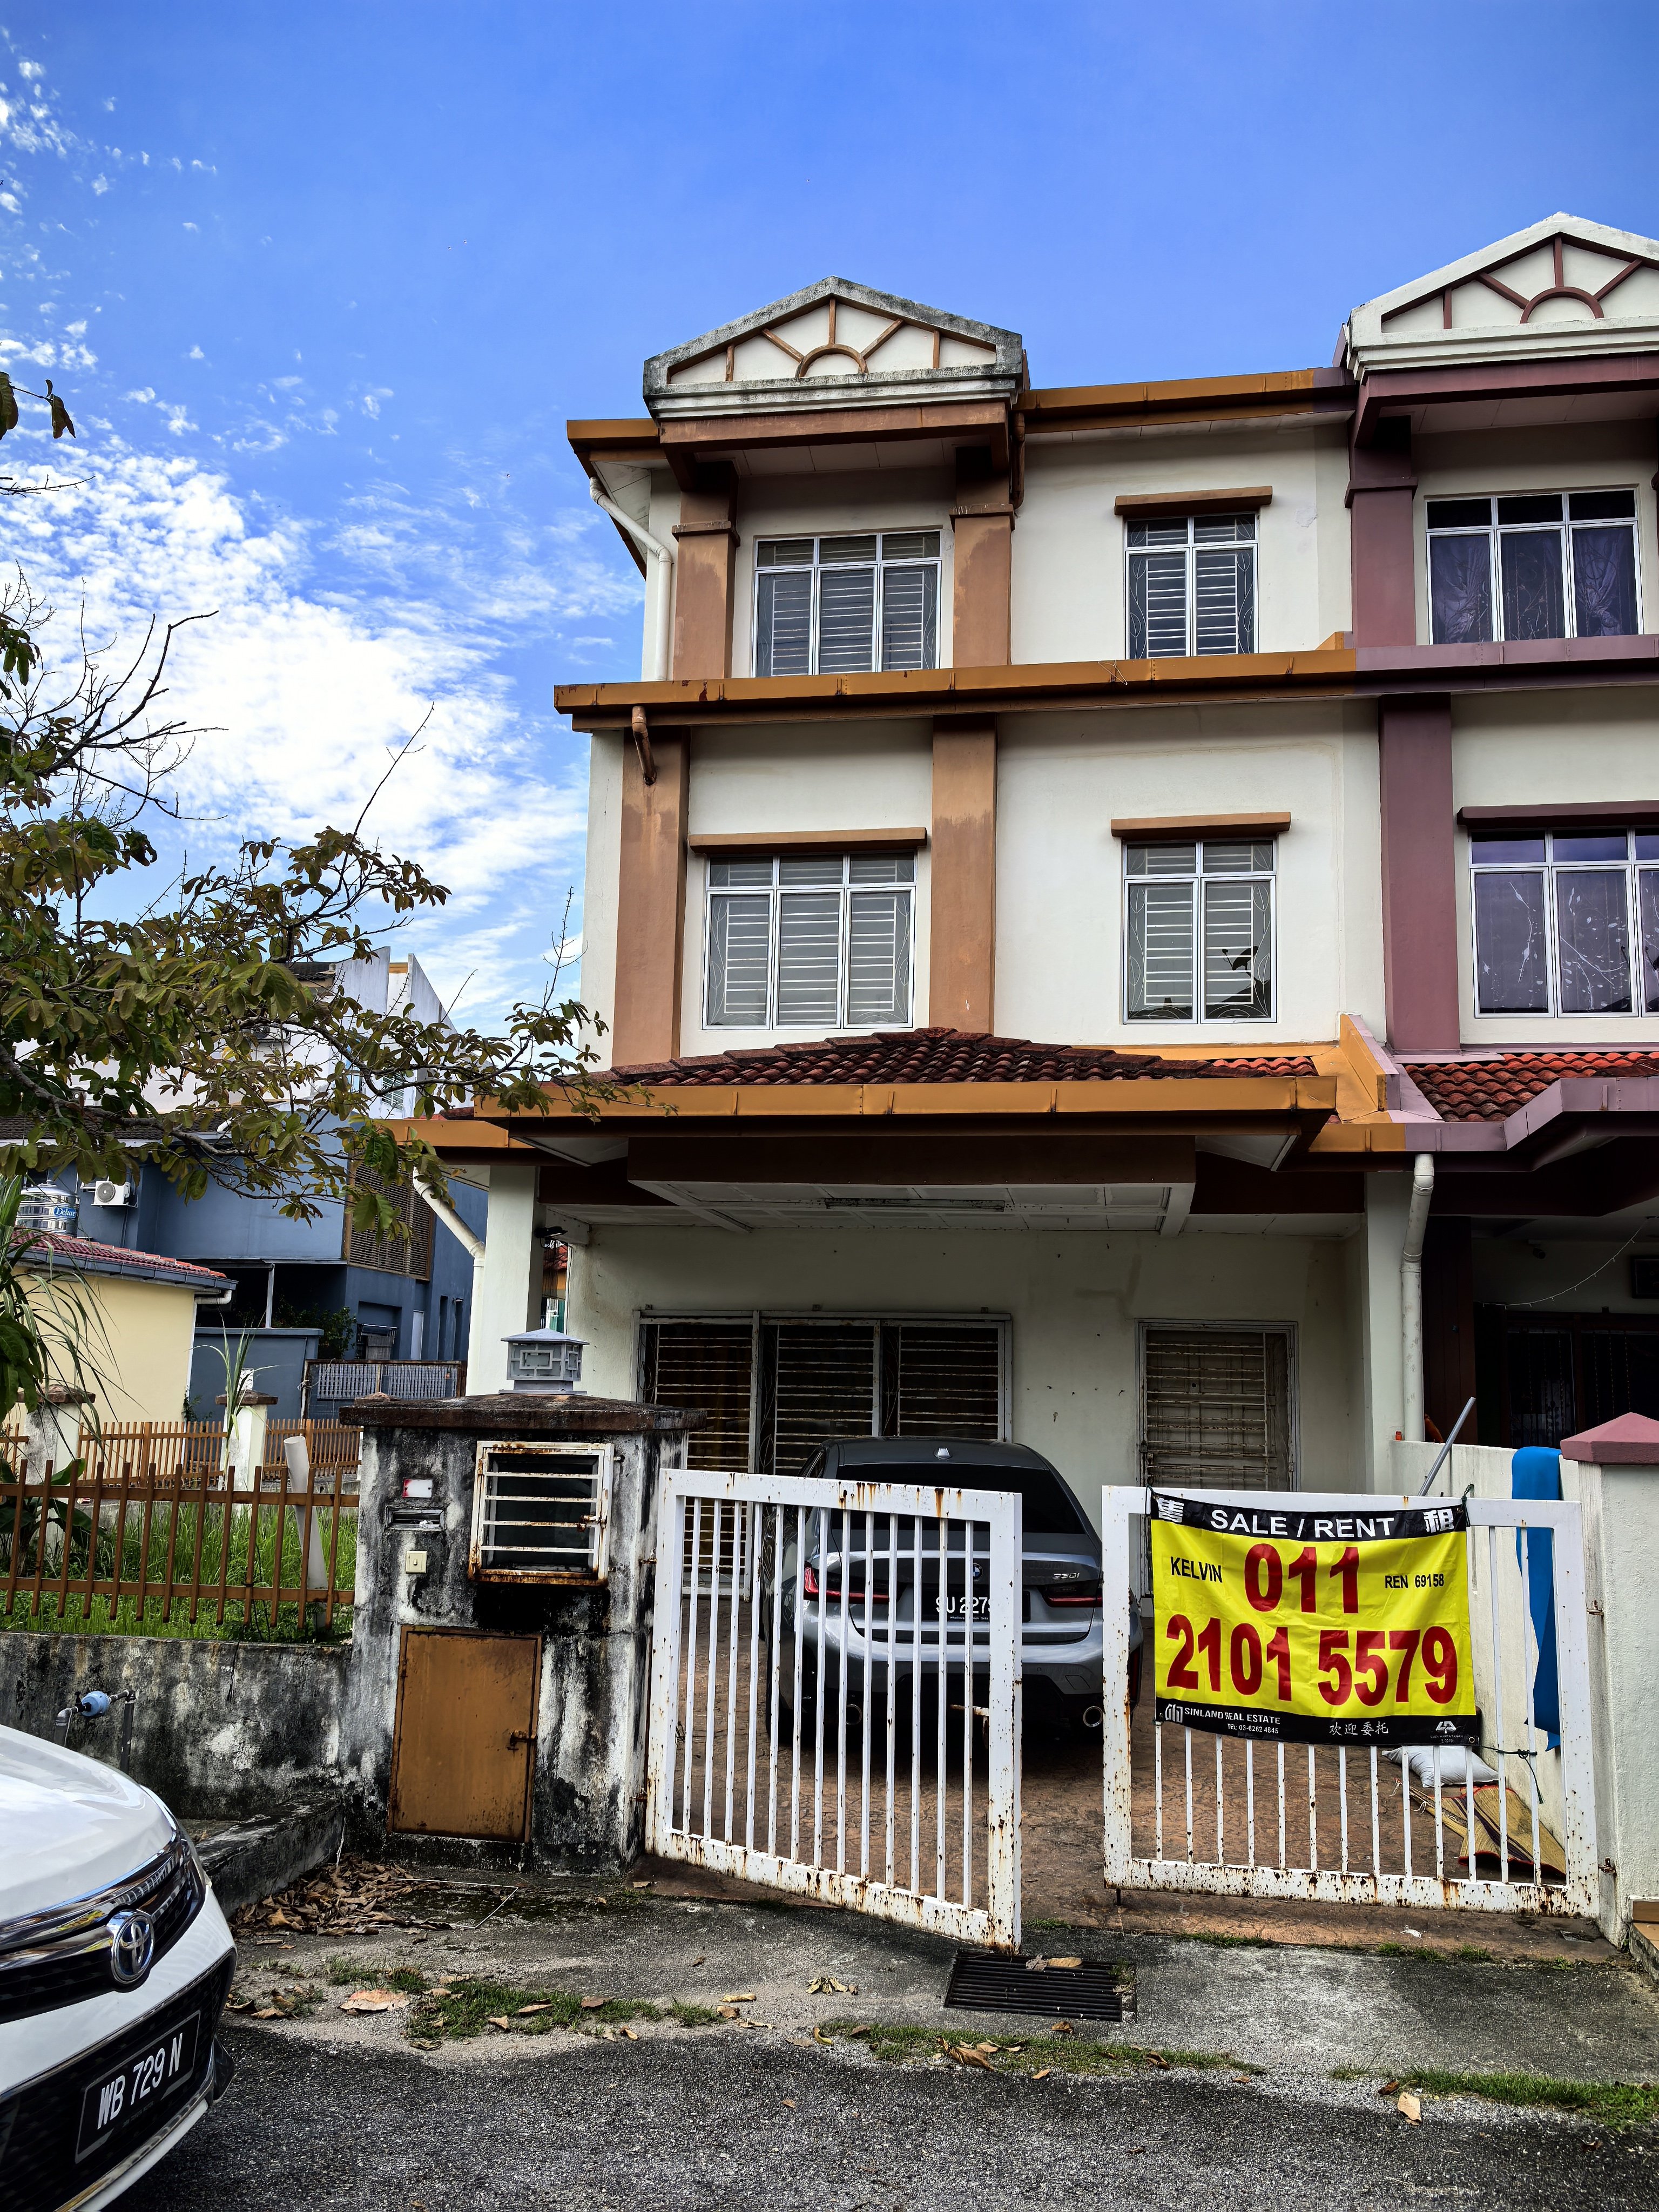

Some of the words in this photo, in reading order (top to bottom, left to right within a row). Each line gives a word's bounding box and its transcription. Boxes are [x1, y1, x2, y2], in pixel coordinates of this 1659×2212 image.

[1157, 1497, 1184, 1523] 售
[1423, 1508, 1455, 1533] 租
[1210, 1509, 1288, 1535] SALE
[1314, 1517, 1395, 1538] RENT
[1170, 1556, 1223, 1583] KELVIN
[1244, 1543, 1359, 1614] 011
[1385, 1574, 1408, 1588] REN
[1415, 1573, 1445, 1588] 69158
[960, 1596, 990, 1614] 227
[1166, 1614, 1292, 1702] 2101
[1318, 1626, 1458, 1707] 5579
[1184, 1707, 1224, 1719] SINLAND
[1225, 1712, 1245, 1721] REAL
[1246, 1714, 1280, 1725] ESTATE
[1239, 1724, 1263, 1732] 03-6262
[1328, 1721, 1389, 1736] 欢迎委托
[97, 2074, 126, 2130] WB
[131, 2048, 165, 2106] 729
[168, 2032, 183, 2077] N
